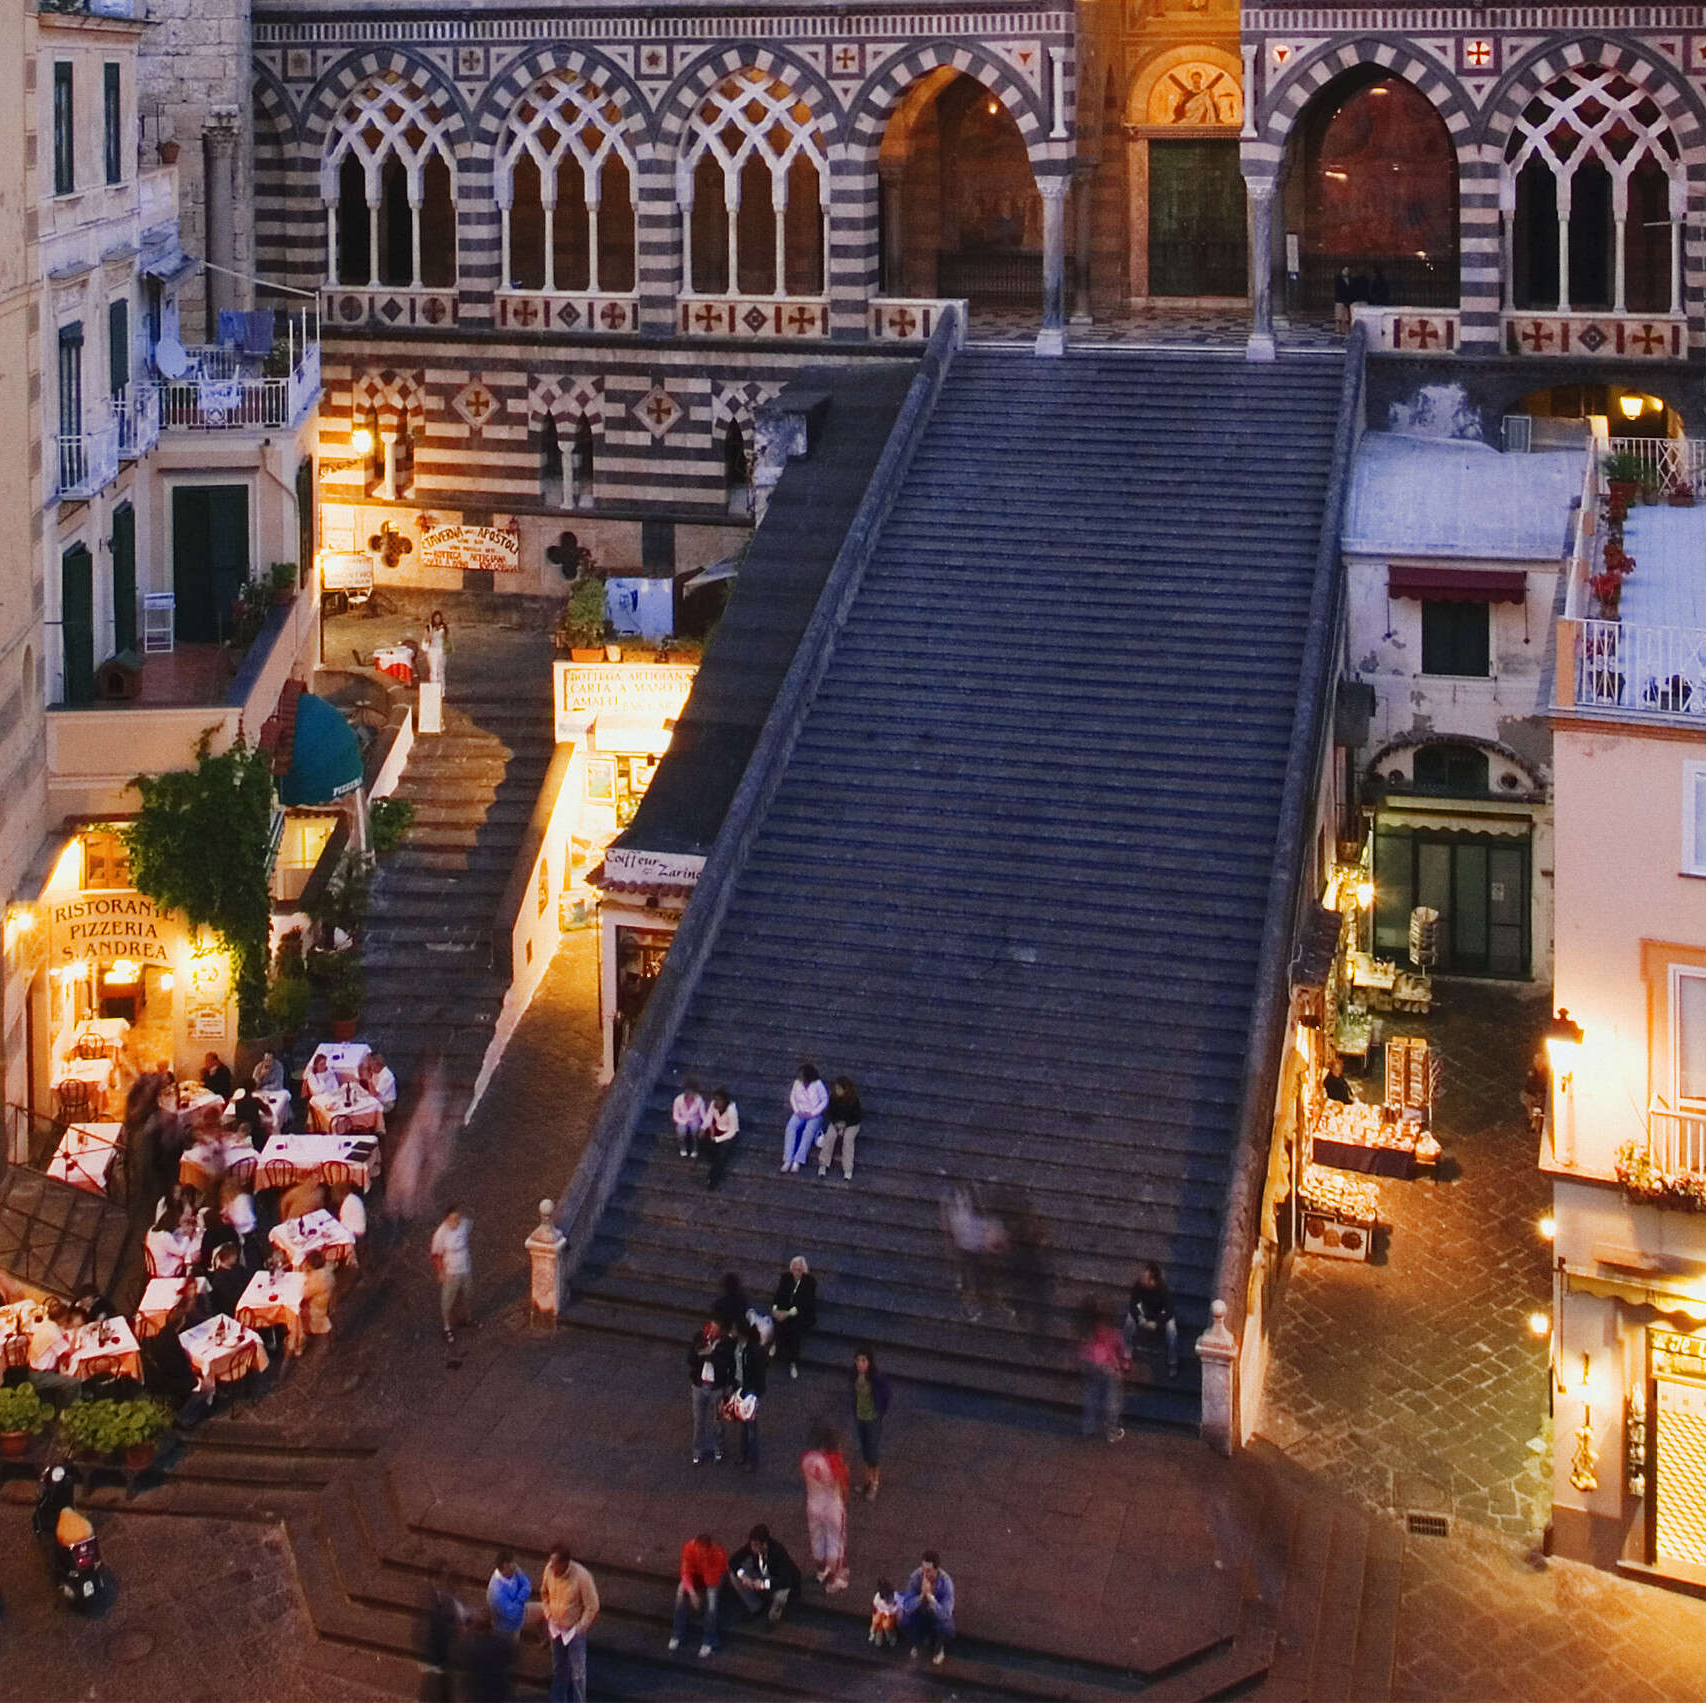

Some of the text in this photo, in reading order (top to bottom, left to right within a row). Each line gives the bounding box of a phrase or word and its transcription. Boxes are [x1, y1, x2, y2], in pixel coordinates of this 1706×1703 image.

[424, 526, 464, 548] TAVERNA
[570, 672, 622, 682] BOTTEGA
[570, 683, 612, 694] CARTA
[620, 683, 628, 694] A
[605, 849, 660, 869] Coiffeur
[55, 899, 175, 924] RISTORANTE
[70, 921, 158, 940] PIZZERIA
[62, 941, 168, 961] S. ANDREA
